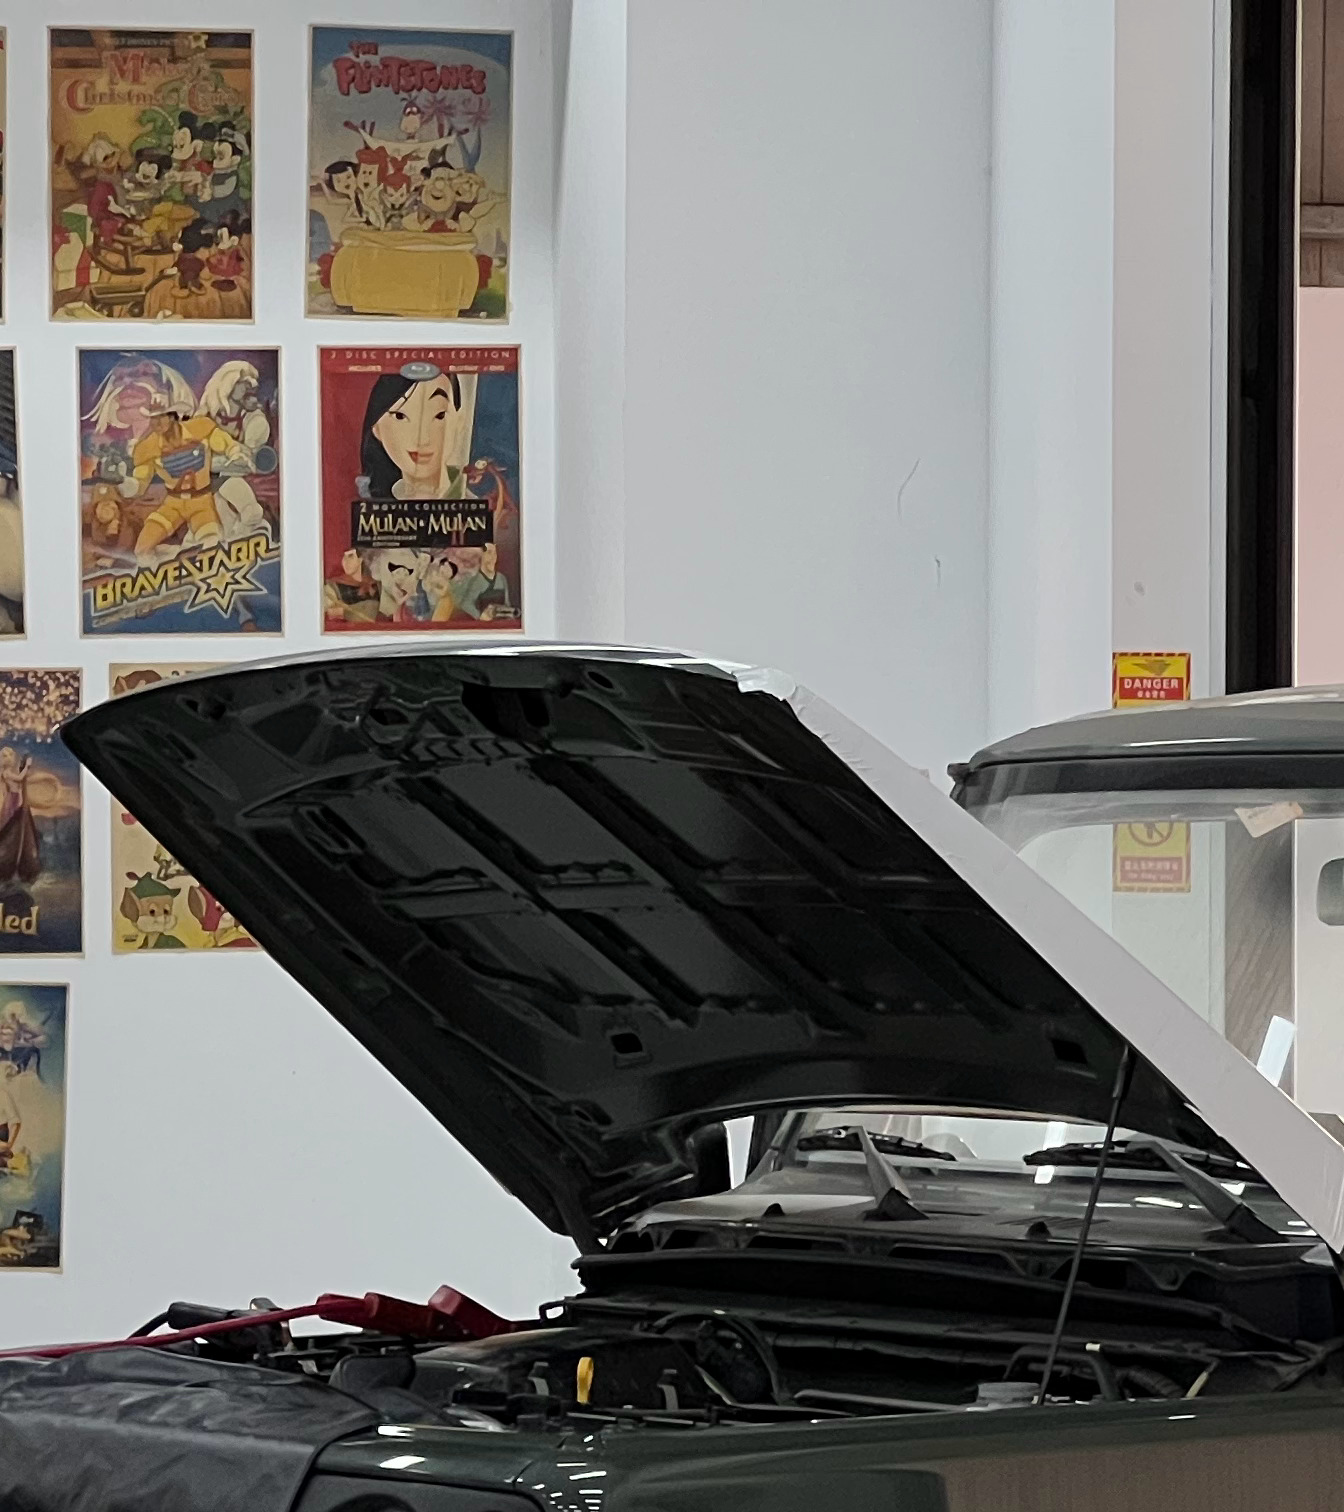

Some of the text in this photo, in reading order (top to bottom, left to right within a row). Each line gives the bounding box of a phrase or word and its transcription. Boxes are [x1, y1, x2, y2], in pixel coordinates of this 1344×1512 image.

[332, 57, 487, 95] FLINTSTONES
[360, 502, 366, 513] 2
[1123, 678, 1179, 689] DANGER
